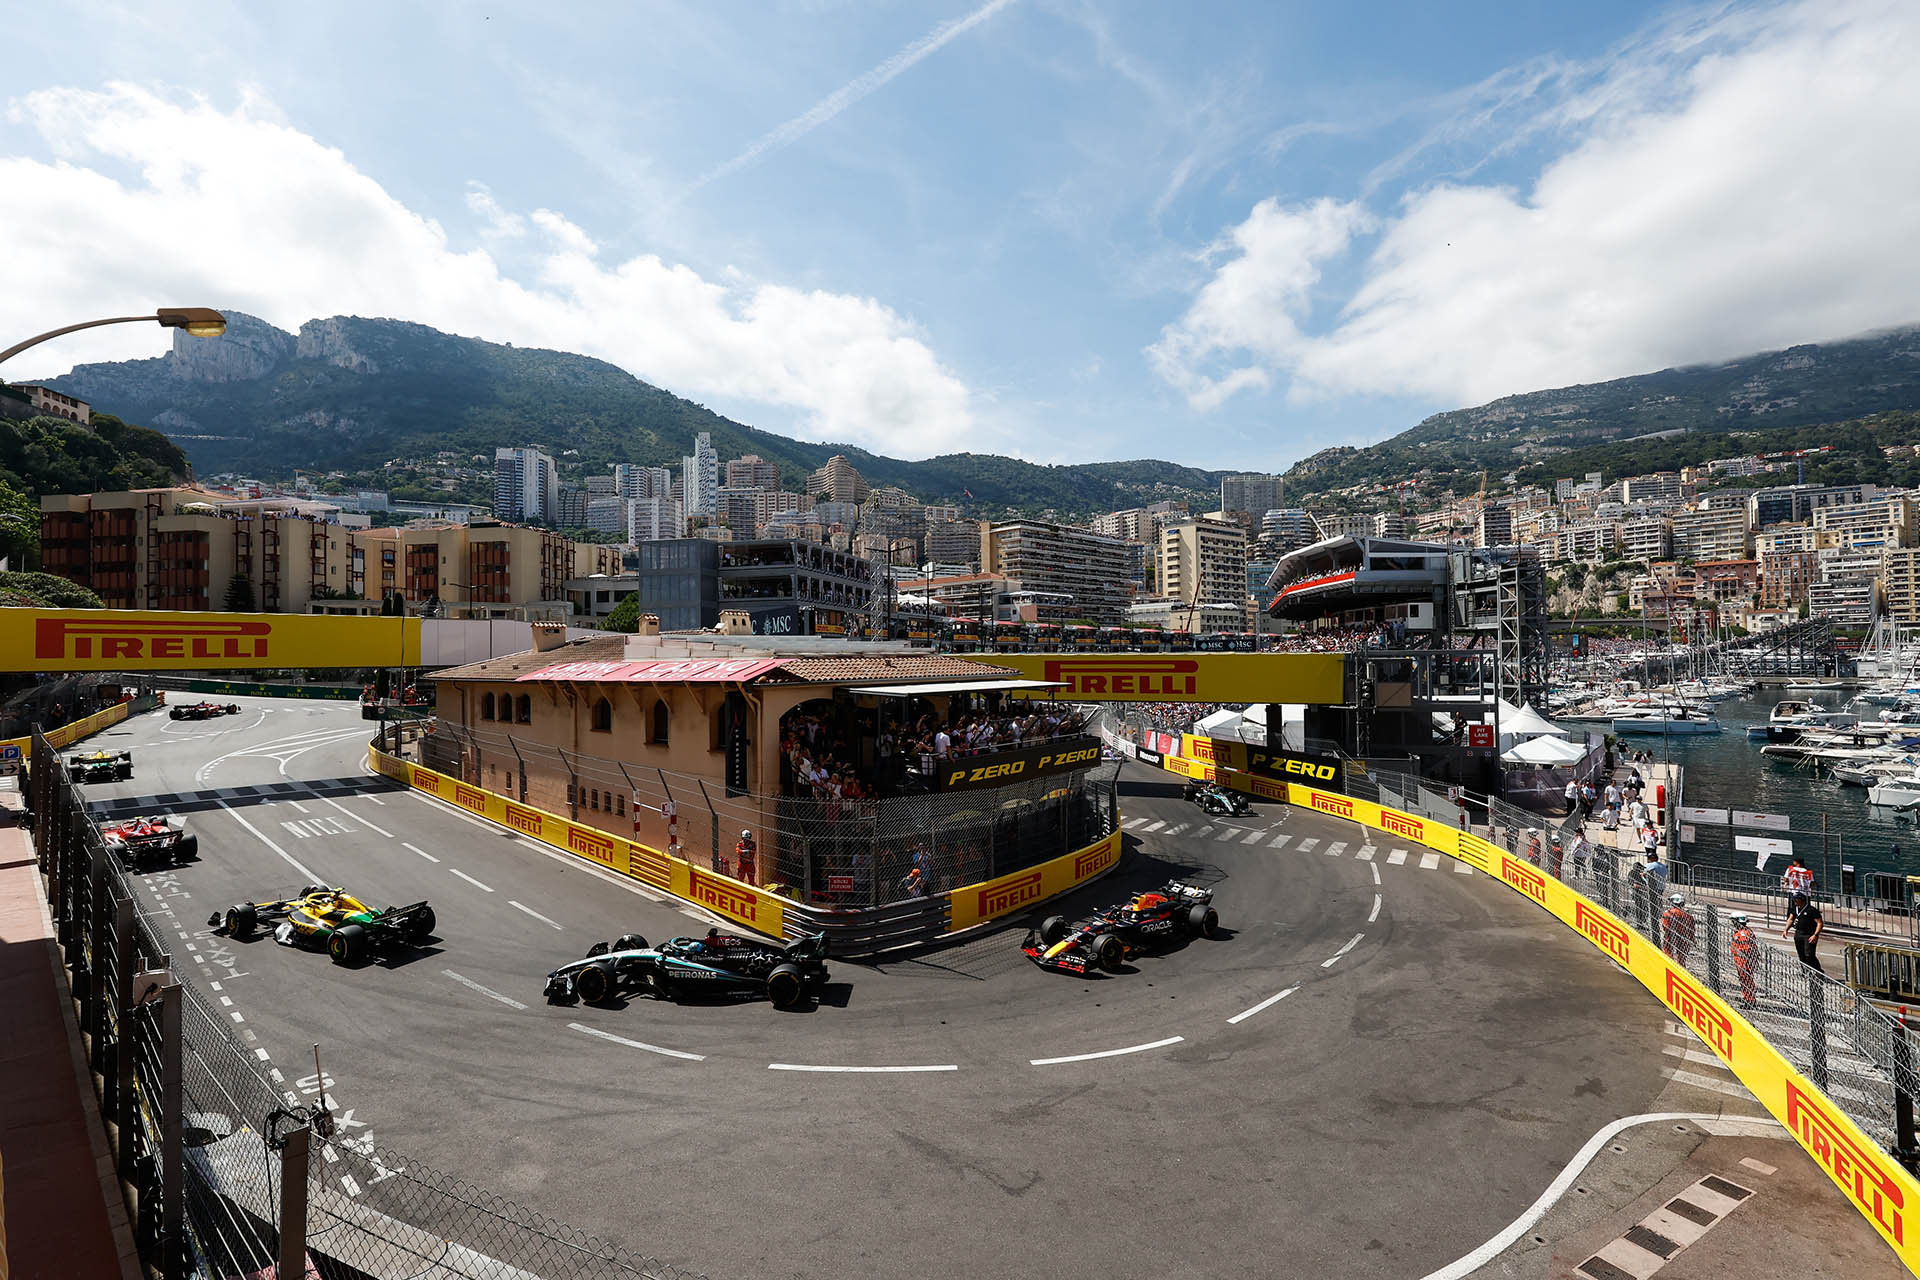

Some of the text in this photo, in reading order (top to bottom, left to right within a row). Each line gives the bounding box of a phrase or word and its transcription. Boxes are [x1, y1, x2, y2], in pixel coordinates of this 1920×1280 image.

[772, 615, 791, 633] MSC
[35, 618, 272, 659] PIRELLI
[1043, 660, 1199, 695] PIRELLI
[1039, 748, 1098, 769] P ZERO
[1193, 739, 1232, 765] PIRELLI
[949, 761, 1025, 785] P ZERO
[1170, 758, 1190, 775] PIRELLI
[1252, 753, 1336, 781] P ZERO
[414, 769, 439, 793] PIRELLI
[1251, 780, 1286, 801] PIRELLI
[456, 785, 485, 812] PIRELLI
[1311, 792, 1353, 817] PIRELLI
[280, 816, 358, 838] NICE
[505, 804, 543, 835] PIRELLI
[1381, 810, 1424, 840] PIRELLI
[568, 826, 614, 863] PIRELLI
[1075, 842, 1112, 880] PIRELLI
[1502, 856, 1545, 903] PIRELLI
[689, 871, 757, 921] PIRELLI
[978, 872, 1042, 918] PIRELLI
[1140, 920, 1173, 933] ORACLE
[1576, 901, 1630, 964] PIRELLI
[717, 938, 742, 946] INEOS
[668, 970, 717, 980] PETRONAS
[1665, 967, 1733, 1062] PIRELLI
[1786, 1079, 1904, 1247] PIRELLI
